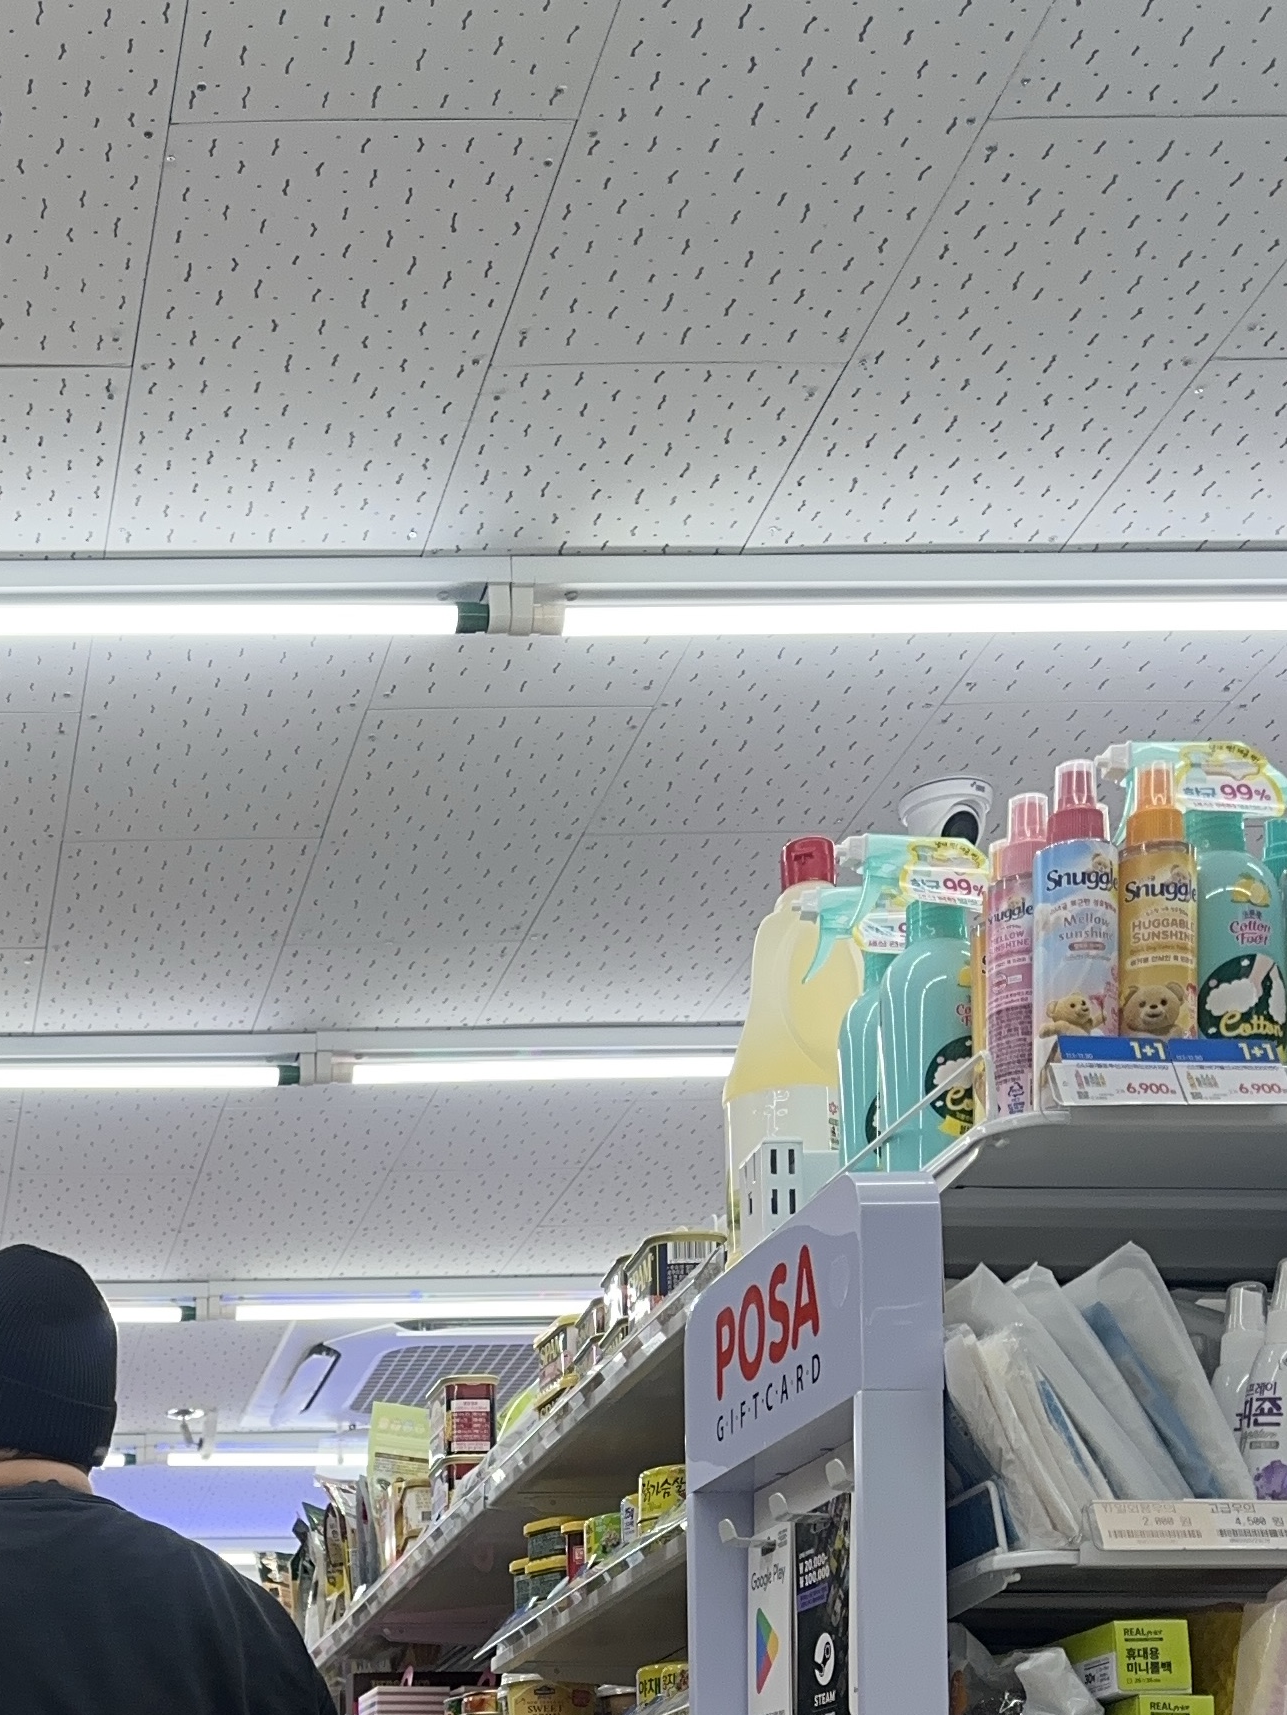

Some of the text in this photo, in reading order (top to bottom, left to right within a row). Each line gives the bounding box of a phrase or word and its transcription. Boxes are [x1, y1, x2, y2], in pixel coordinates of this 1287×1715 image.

[1125, 879, 1197, 904] Snuggle
[1064, 912, 1110, 927] Mellow
[1132, 929, 1195, 945] SUNSHINE
[1219, 1010, 1284, 1037] Cotton
[1129, 1041, 1166, 1060] 1+1
[1239, 1042, 1275, 1061] 1+1
[1127, 1083, 1170, 1095] 6,900
[1239, 1083, 1281, 1095] 6,900
[717, 1245, 820, 1401] POSA
[751, 1563, 786, 1591] Google Play
[1124, 1628, 1146, 1636] REAL
[1126, 1647, 1160, 1660] 휴대용
[1126, 1661, 1172, 1675] 미니롤백
[814, 1690, 836, 1707] STEAM
[1150, 1702, 1172, 1711] REAL
